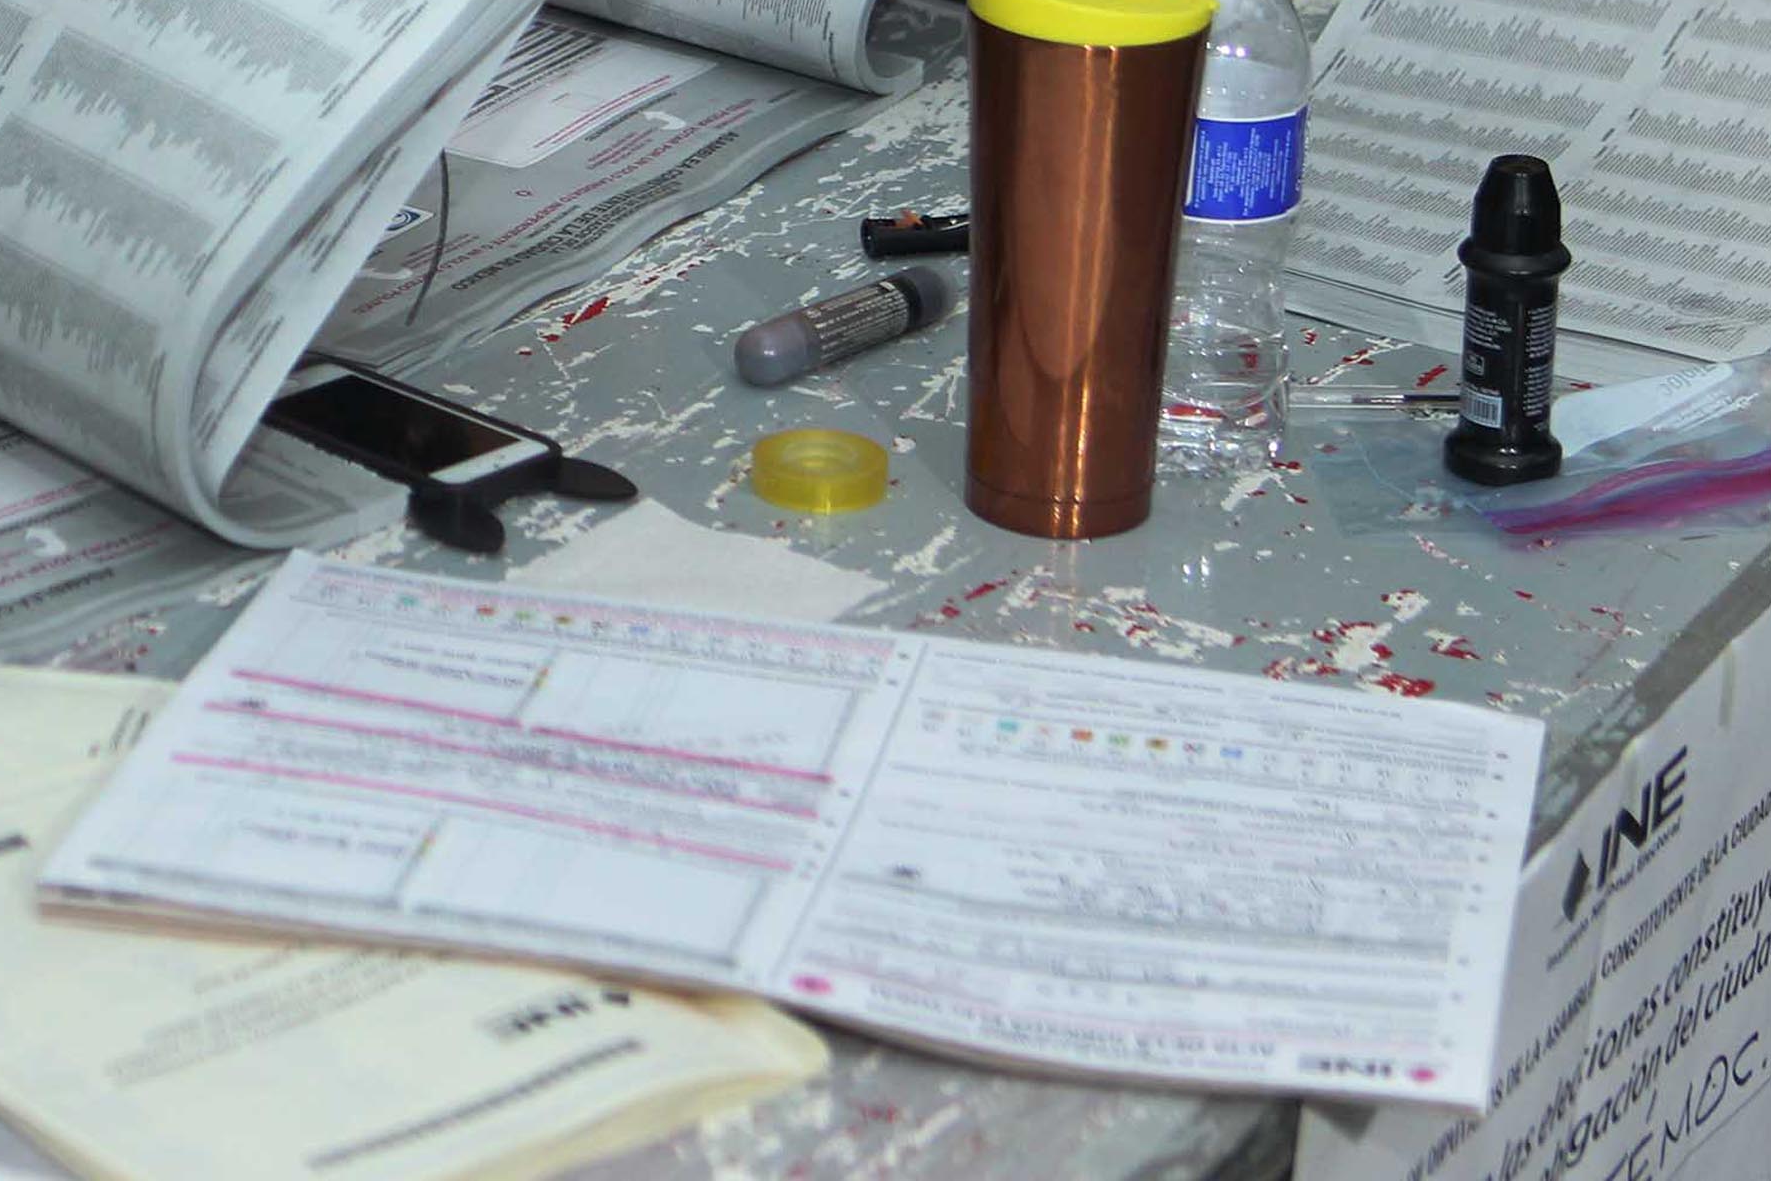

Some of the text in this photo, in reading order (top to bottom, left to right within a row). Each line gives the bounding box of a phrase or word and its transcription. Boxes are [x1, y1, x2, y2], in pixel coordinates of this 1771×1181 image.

[674, 131, 740, 172] ASAMBLEA
[1597, 744, 1688, 892] INE
[1601, 867, 1698, 980] CONSTITUYENTE
[1696, 847, 1715, 885] DE
[1713, 831, 1730, 866] LA
[1664, 869, 1771, 1007] constituy
[1665, 983, 1704, 1066] del
[1703, 931, 1771, 1021] ciuda
